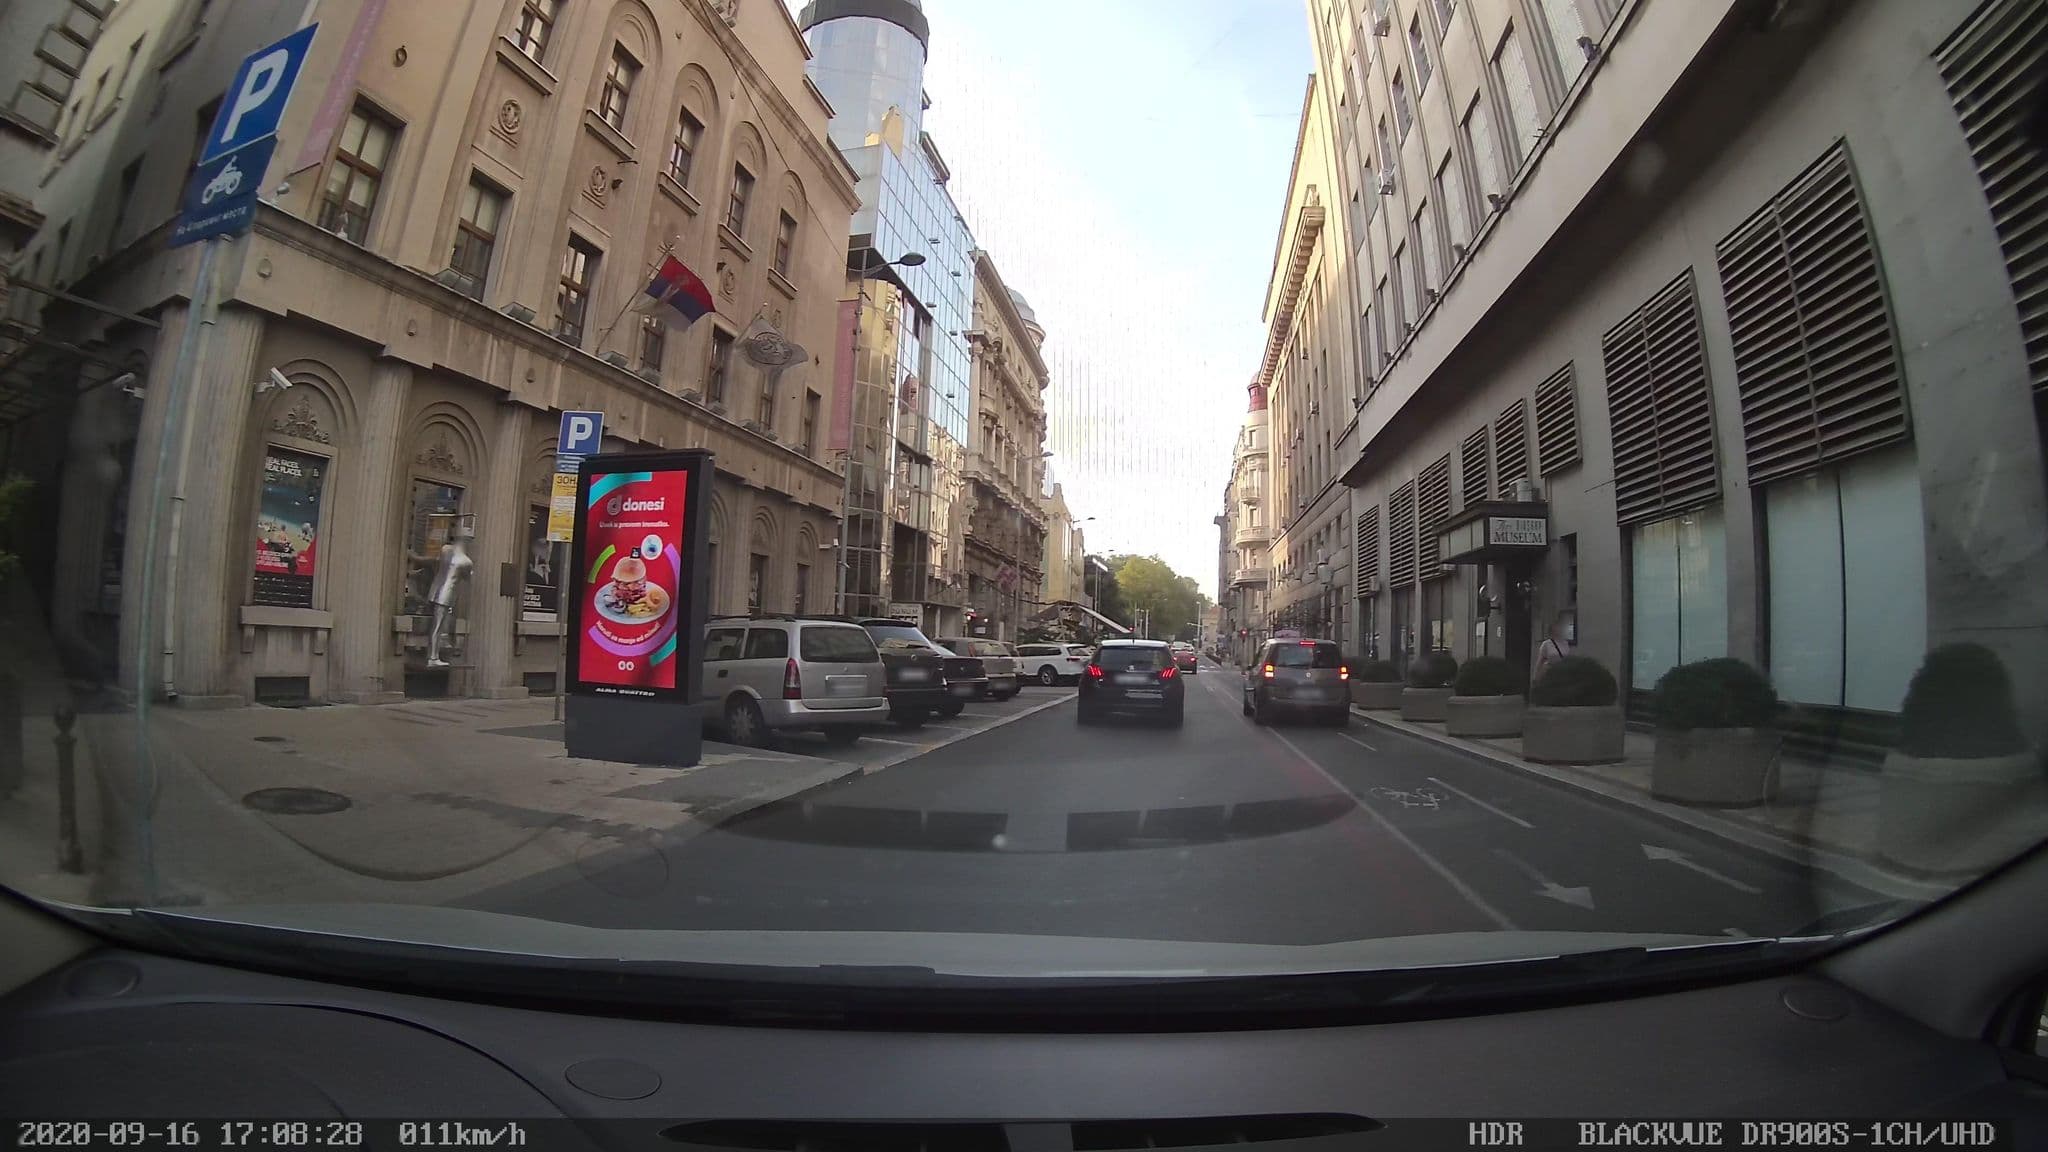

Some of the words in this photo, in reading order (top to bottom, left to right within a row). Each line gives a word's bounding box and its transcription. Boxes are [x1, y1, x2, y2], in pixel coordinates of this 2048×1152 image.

[220, 48, 289, 145] P
[567, 416, 593, 449] P
[622, 497, 665, 511] donesi
[1494, 531, 1543, 544] MUSEUM
